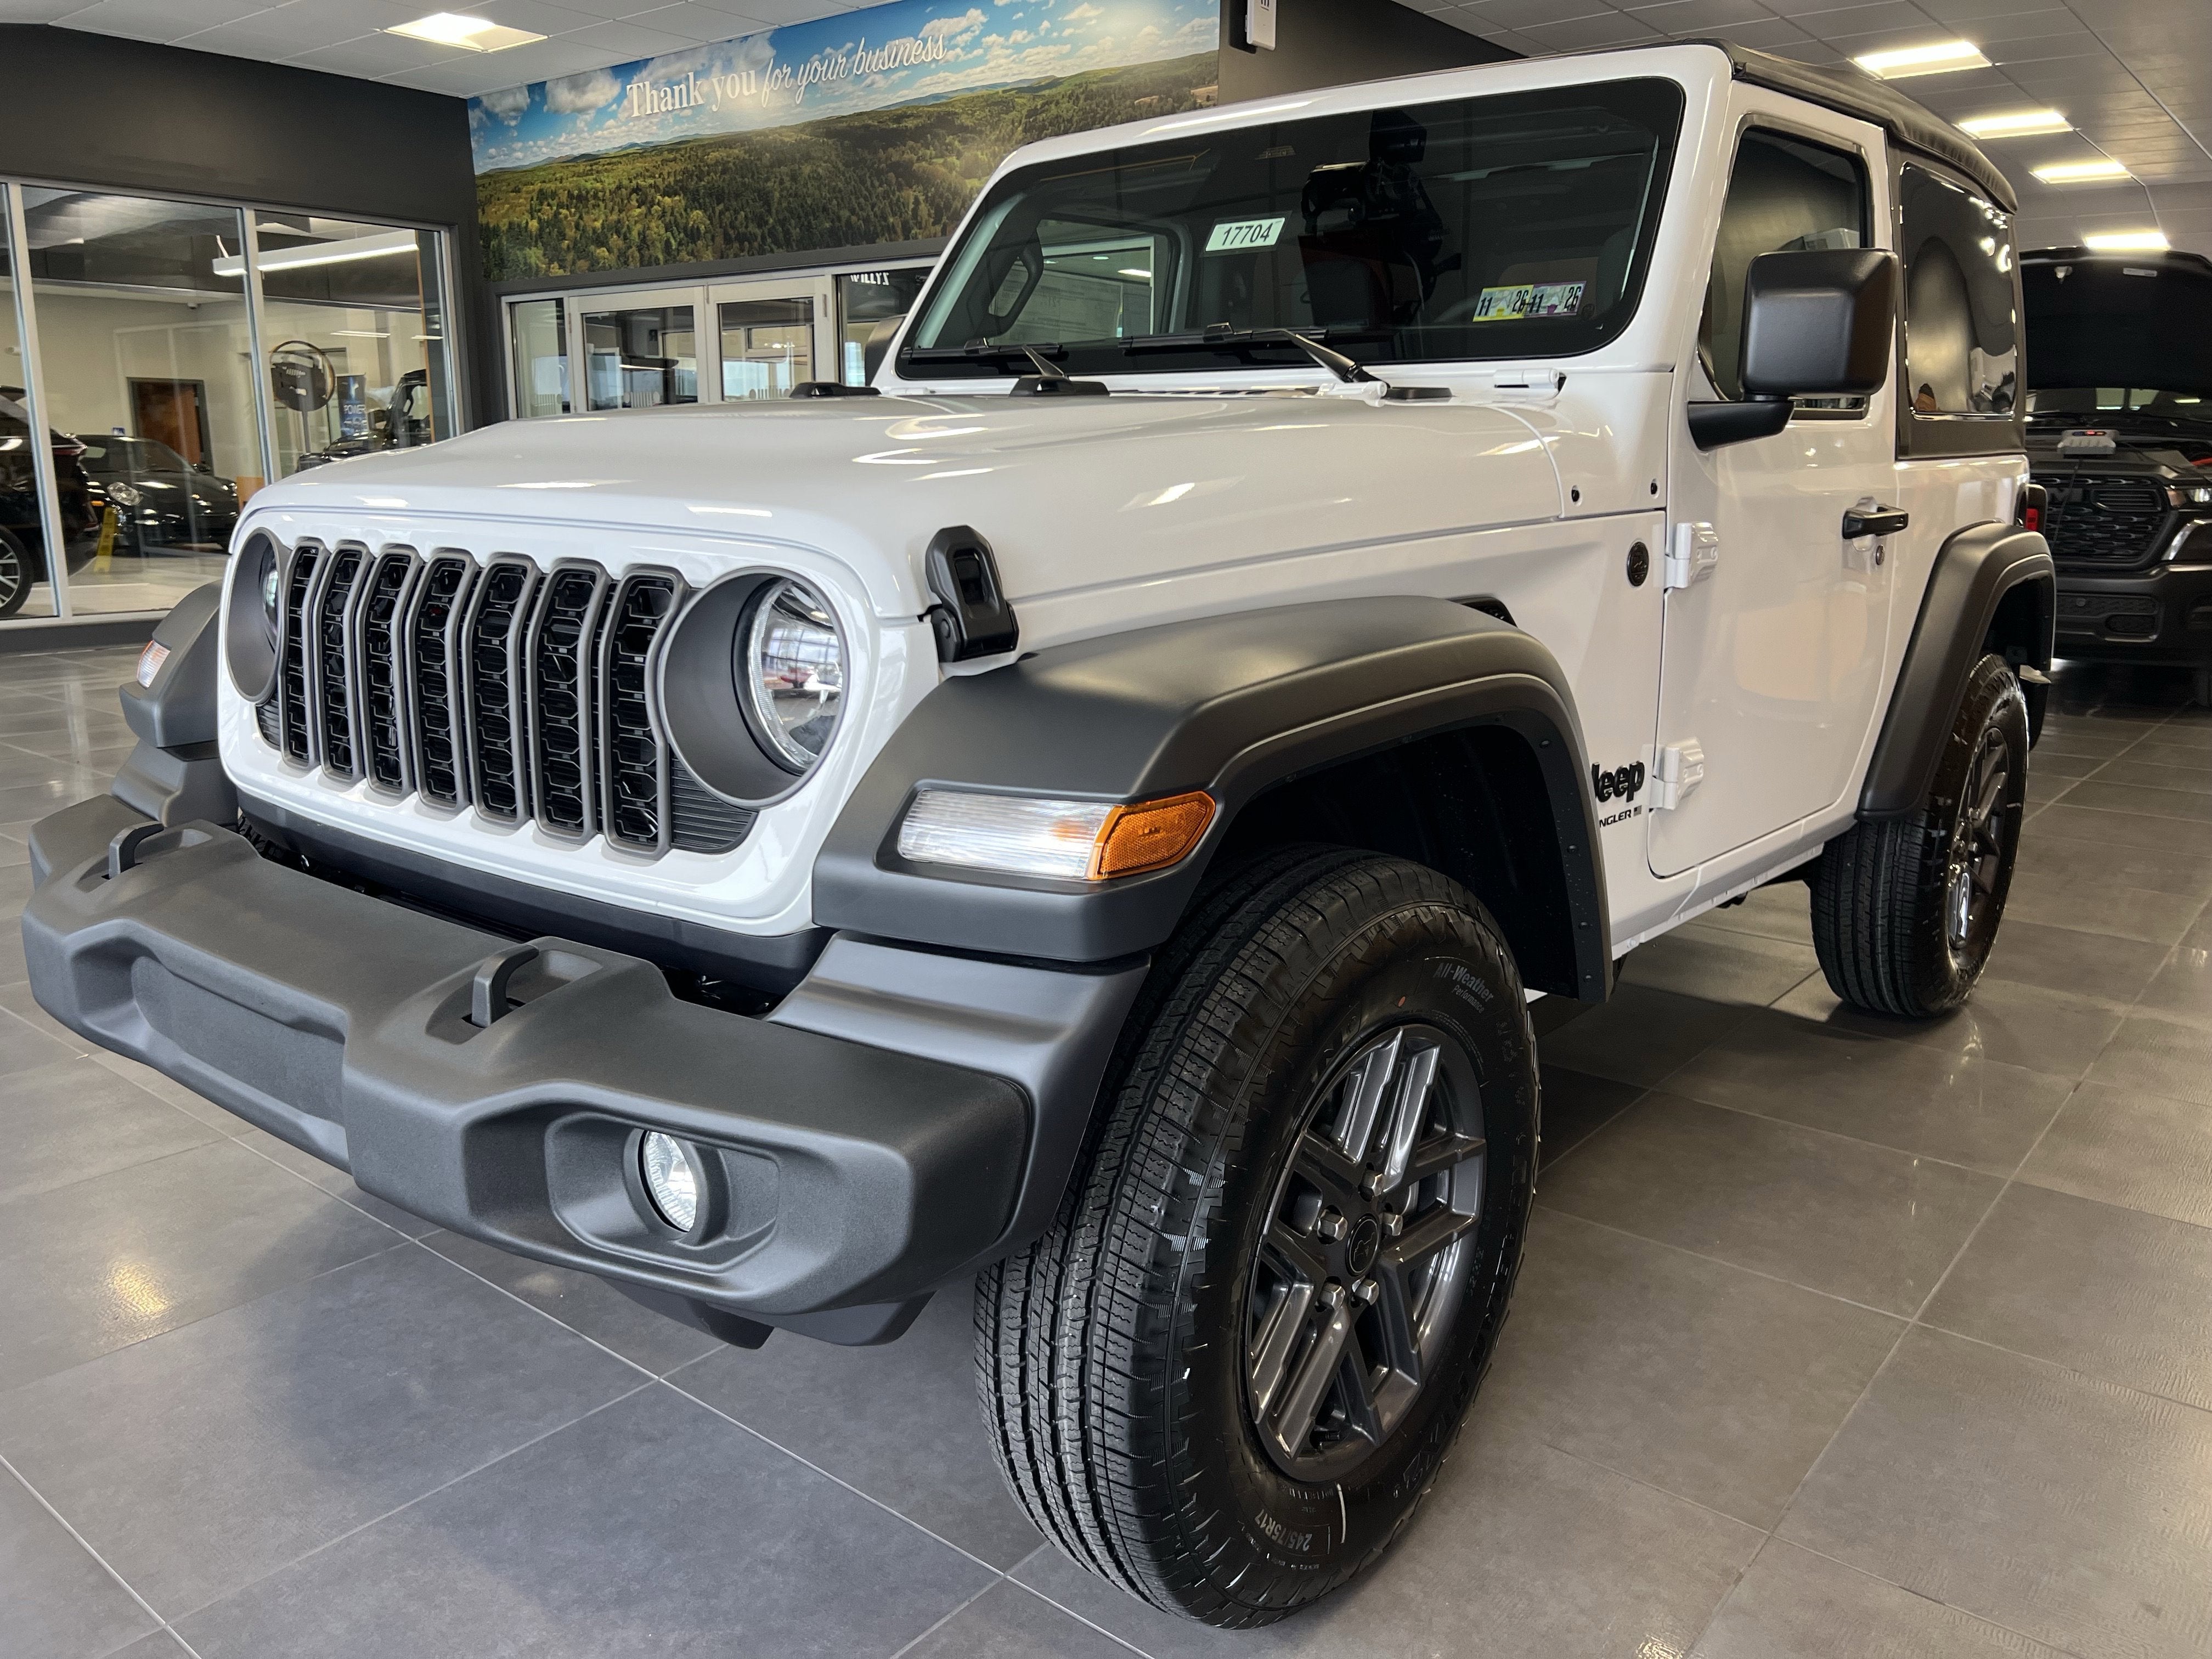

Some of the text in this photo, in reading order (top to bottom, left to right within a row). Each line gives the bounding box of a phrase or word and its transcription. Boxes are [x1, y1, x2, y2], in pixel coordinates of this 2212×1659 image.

[627, 33, 947, 117] Thank you for your business
[1222, 223, 1273, 246] 17704
[850, 272, 889, 285] WILLYS
[1478, 297, 1493, 316] 11
[1529, 286, 1582, 313] 11 26
[1592, 760, 1645, 803] Jeep
[1599, 809, 1632, 828] NGLER
[1433, 963, 1493, 1002] All-Weather
[1452, 985, 1485, 1014] Performance
[1255, 1509, 1312, 1551] 245/75R17
